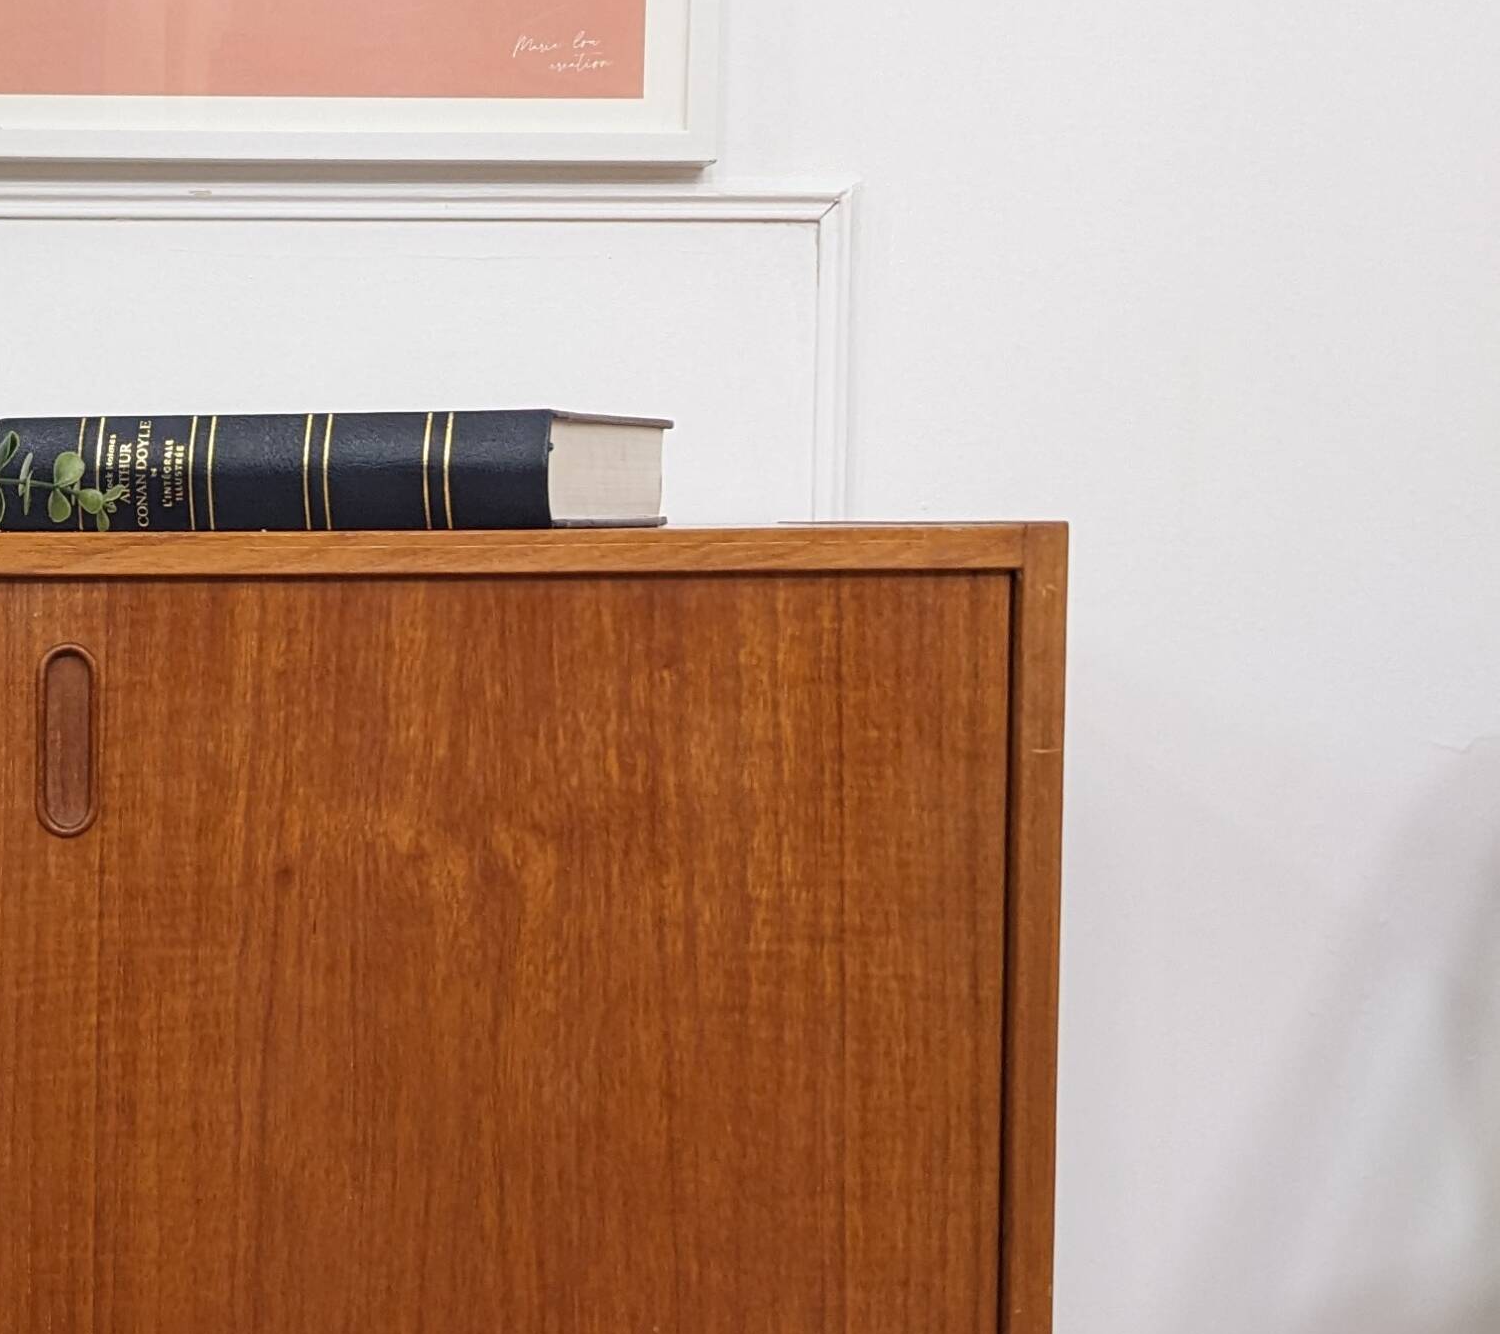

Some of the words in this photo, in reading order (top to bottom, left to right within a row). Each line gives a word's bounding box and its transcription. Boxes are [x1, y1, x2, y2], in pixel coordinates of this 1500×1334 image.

[136, 420, 151, 469] DOYLE
[119, 443, 132, 504] ARTHUR
[136, 475, 149, 527] CONAN
